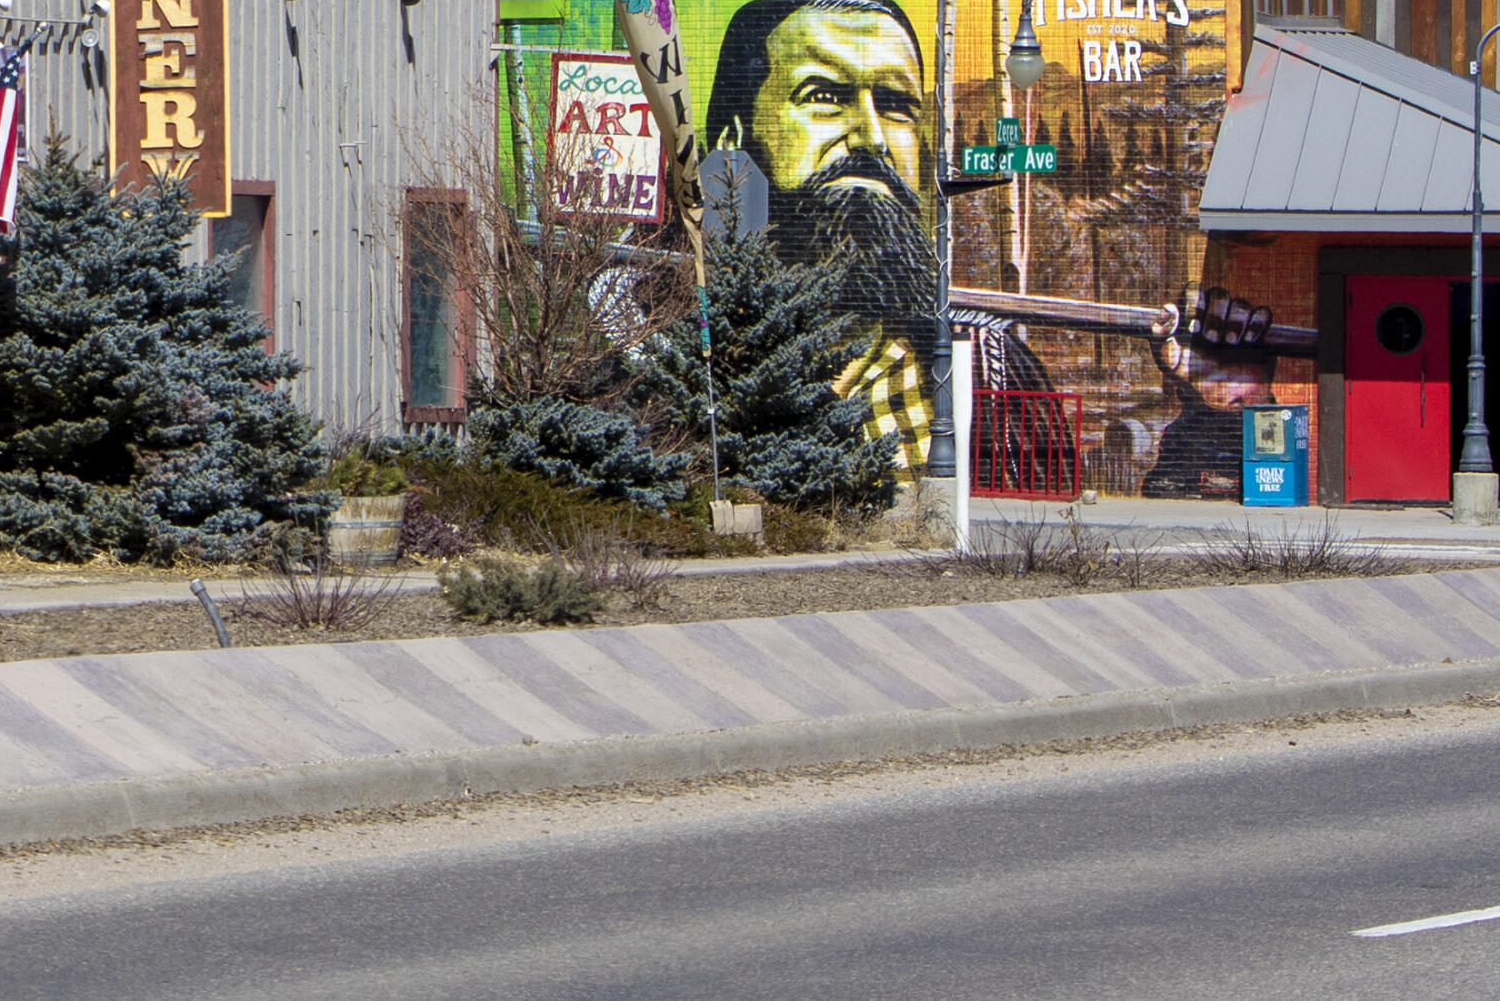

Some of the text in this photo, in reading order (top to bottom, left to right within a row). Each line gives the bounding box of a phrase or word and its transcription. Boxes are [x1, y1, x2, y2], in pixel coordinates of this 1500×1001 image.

[1083, 40, 1143, 82] BAR
[559, 64, 644, 95] Loca
[557, 100, 653, 137] ART
[964, 147, 1054, 170] Fraser Ave
[1260, 475, 1284, 484] NEWS
[1260, 484, 1281, 492] FREE
